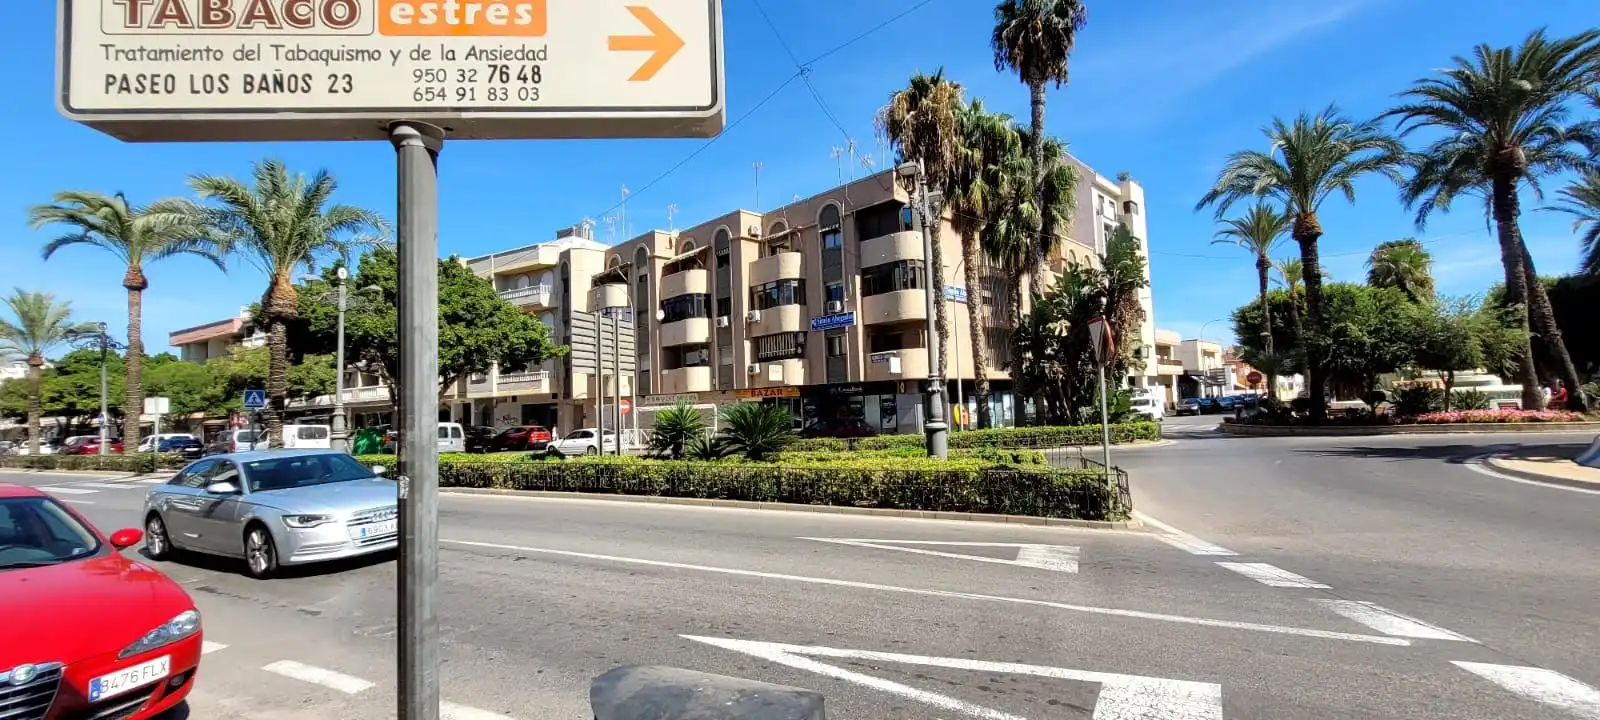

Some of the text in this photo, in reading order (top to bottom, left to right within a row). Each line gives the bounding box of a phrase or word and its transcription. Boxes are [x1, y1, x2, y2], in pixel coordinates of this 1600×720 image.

[113, 0, 361, 29] TABACO
[99, 43, 548, 67] Tratamiento del Tabaquismo y de la Ansiedad
[104, 69, 354, 95] PASEO LOS BAÑOS 23
[412, 64, 542, 84] 950 32 76 48
[412, 86, 540, 102] 654 91 83 03
[751, 388, 784, 397] BAZAR
[143, 660, 167, 680] FLX
